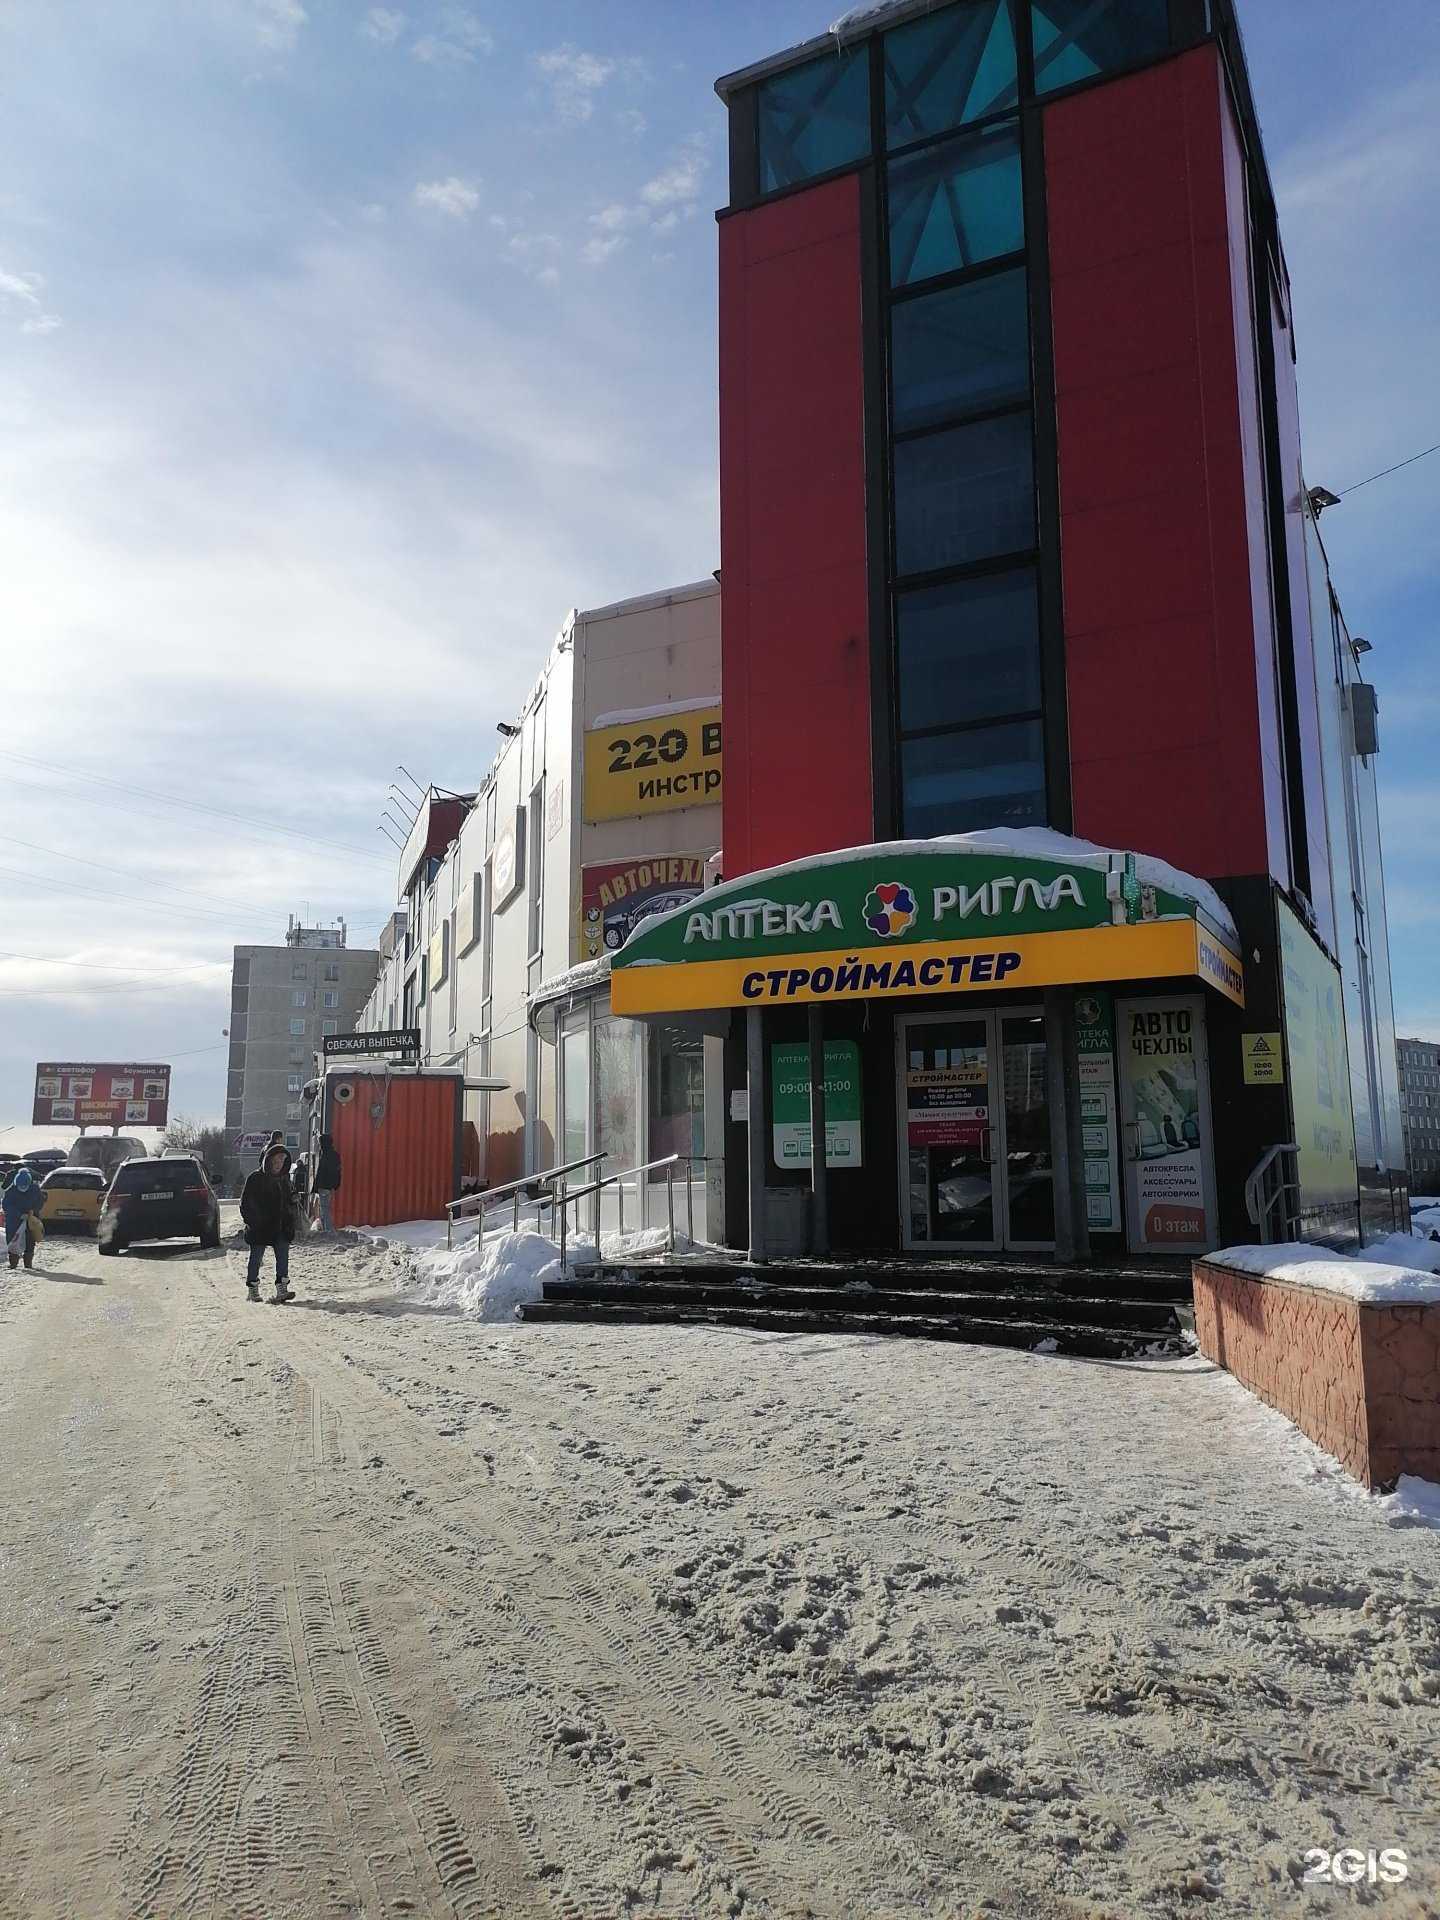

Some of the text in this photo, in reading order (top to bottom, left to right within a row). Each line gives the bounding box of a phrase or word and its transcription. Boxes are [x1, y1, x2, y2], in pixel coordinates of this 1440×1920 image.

[608, 727, 689, 773] 220
[683, 873, 1088, 944] АПТЕКА РИГЛА
[742, 952, 1022, 1001] СТРОЙМАСТЕР
[1132, 1010, 1192, 1037] АВТО
[326, 1034, 415, 1052] СВЕЖАЯ ВЫПЕЧКА
[1131, 1036, 1193, 1056] ЧЕХЛЫ
[912, 1072, 982, 1083] СТРОЙМАСТЕР
[779, 1082, 810, 1095] 09:00
[1143, 1165, 1195, 1173] АВТОКРЕСЛА
[1143, 1177, 1197, 1186] АКСЕССУАРЫ
[1142, 1190, 1200, 1199] АВТОКОВРИКИ
[1153, 1217, 1199, 1233] 0 этаж
